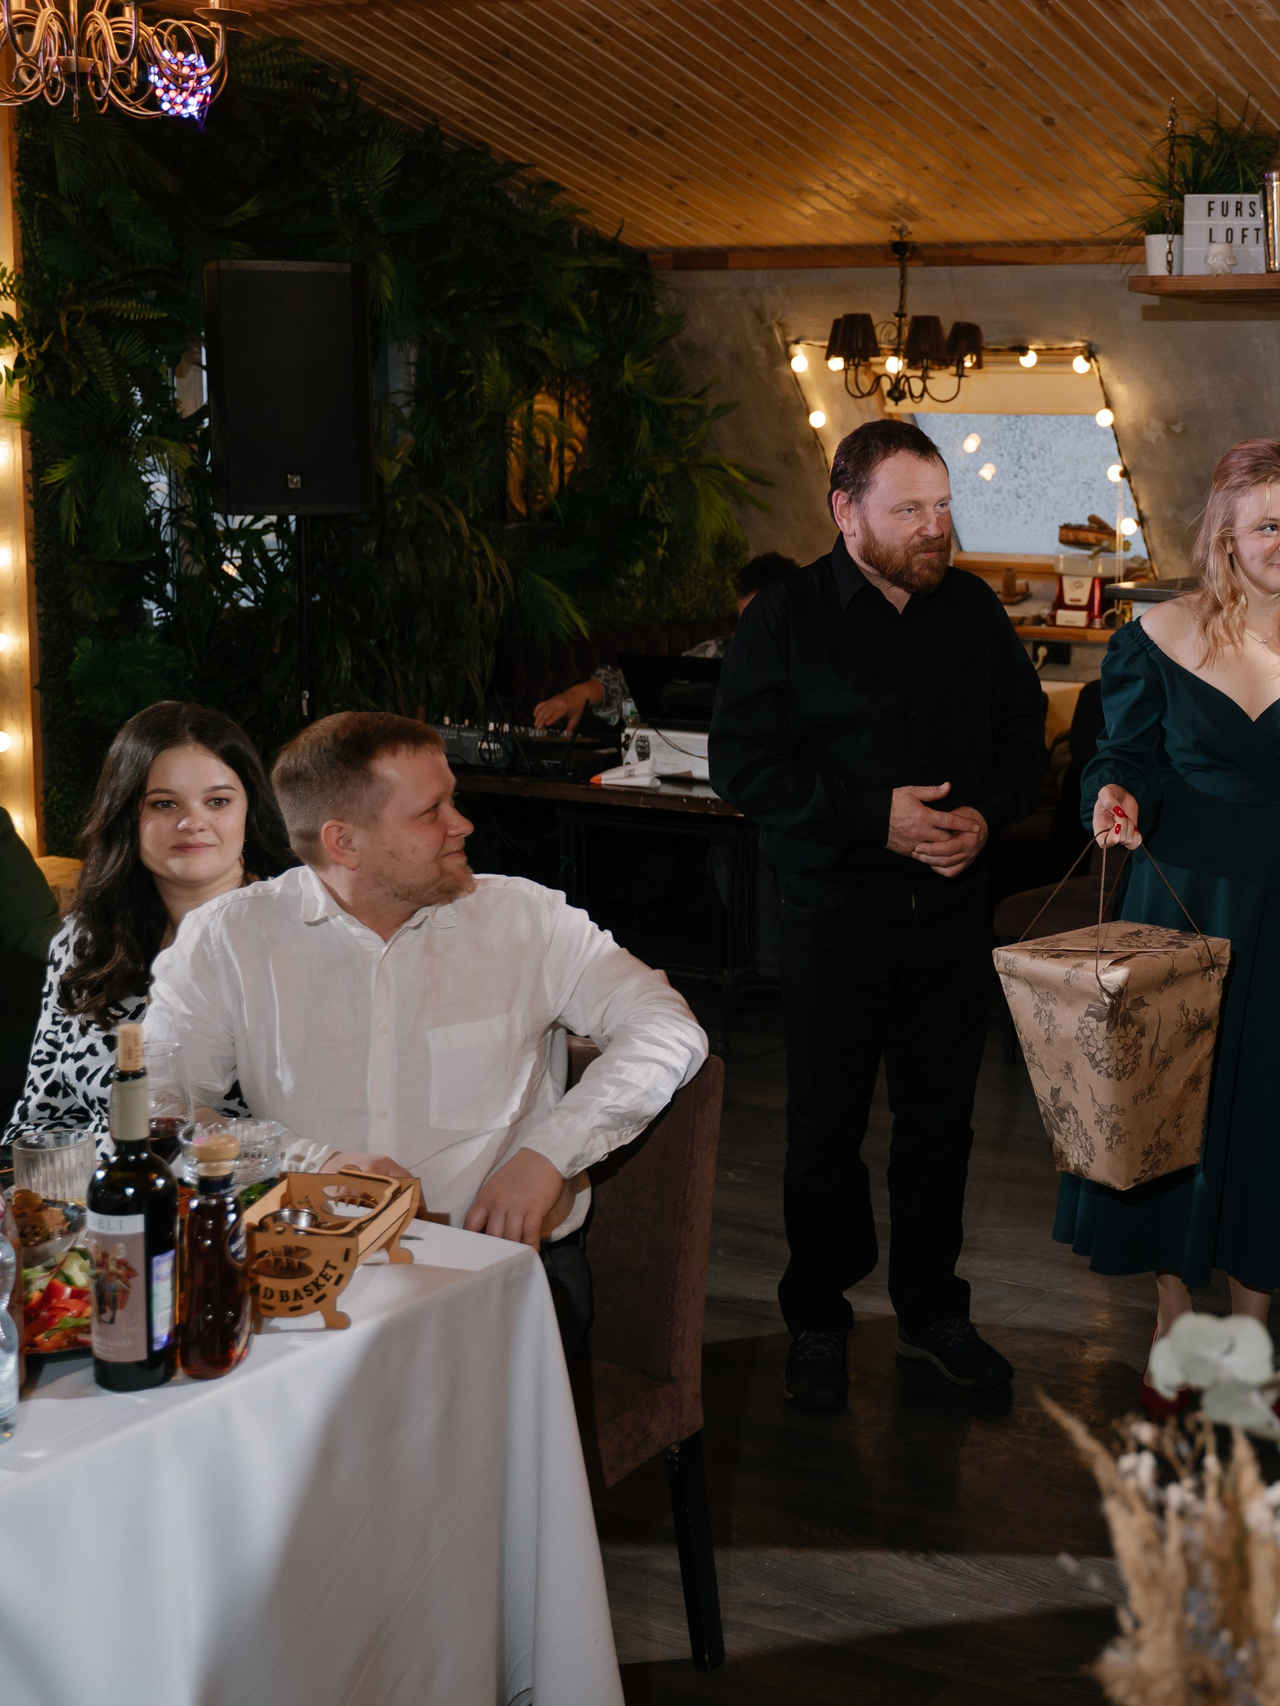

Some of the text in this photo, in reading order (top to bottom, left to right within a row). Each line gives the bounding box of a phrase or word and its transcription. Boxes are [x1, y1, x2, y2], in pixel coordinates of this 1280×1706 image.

[1207, 200, 1257, 218] FURS
[1208, 227, 1262, 245] LOFT
[279, 1259, 339, 1303] BASKET
